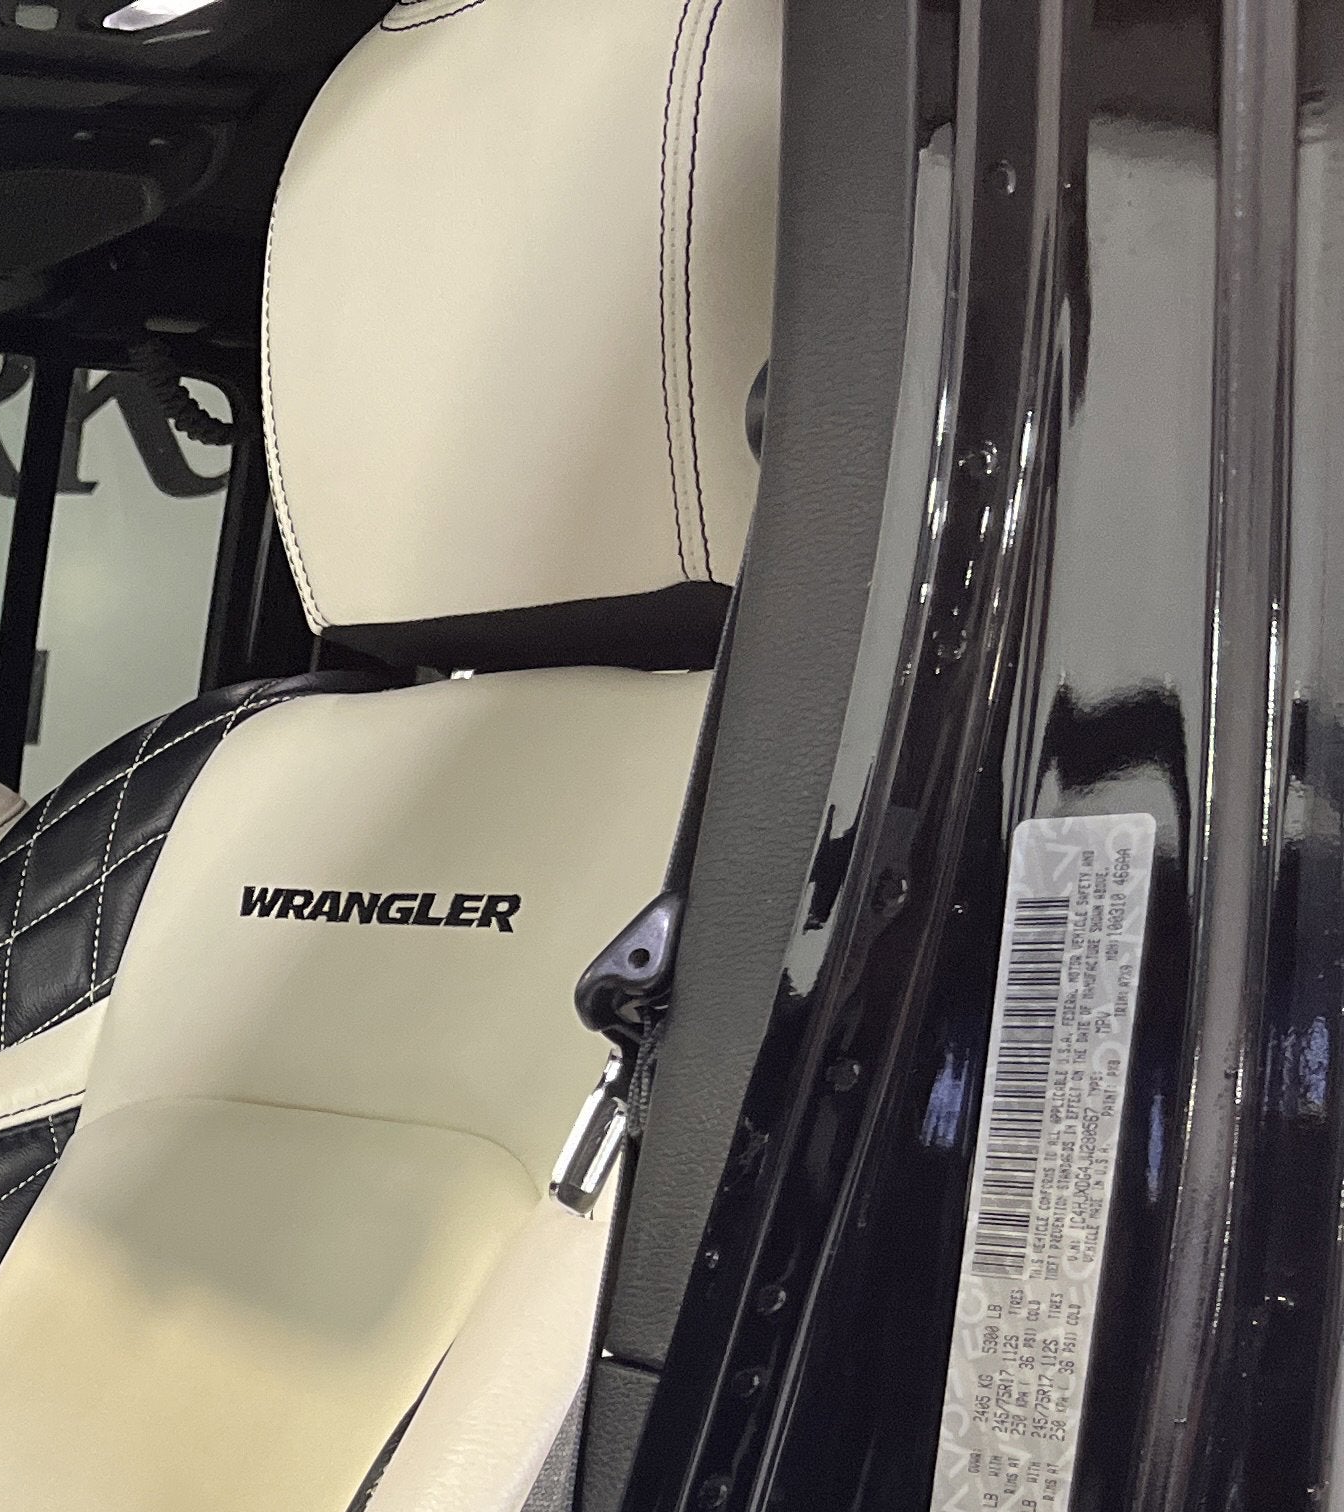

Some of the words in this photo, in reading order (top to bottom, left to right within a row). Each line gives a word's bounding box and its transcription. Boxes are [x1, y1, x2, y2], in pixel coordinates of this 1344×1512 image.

[1081, 850, 1094, 866] AND
[1076, 872, 1092, 905] SAFETY
[240, 886, 522, 933] WRANGLER
[1090, 904, 1105, 932] SHOWN
[1071, 911, 1088, 949] VEHICLE
[1067, 954, 1082, 982] MOTOR
[1081, 939, 1101, 998] MANUFACTURE
[1062, 988, 1078, 1026] FEDERAL
[1079, 1005, 1092, 1015] OF
[1076, 1021, 1090, 1042] DATE
[1094, 1010, 1112, 1033] MPV
[1073, 1048, 1087, 1063] THE
[1071, 1070, 1084, 1080] ON
[1049, 1070, 1068, 1123] APPLICABLE
[1066, 1086, 1082, 1119] EFFECT
[1047, 1129, 1060, 1145] ALL
[1064, 1124, 1076, 1134] IN
[1044, 1151, 1057, 1161] TO
[1057, 1140, 1075, 1189] STANDARDS
[1038, 1167, 1055, 1210] CONFORMS
[1092, 1179, 1105, 1190] IN
[1088, 1197, 1103, 1218] MADE
[1049, 1195, 1068, 1249] PREVENTION
[1033, 1215, 1049, 1253] VEHICLE
[1082, 1224, 1099, 1263] VEHICLE
[1029, 1258, 1043, 1279] THIS
[1045, 1254, 1060, 1281] THEFT
[986, 1302, 1002, 1319] LB
[1008, 1288, 1024, 1316] TIRES
[1026, 1299, 1041, 1322] COLD
[1048, 1292, 1063, 1320] TIRES
[1066, 1303, 1081, 1326] COLD
[982, 1324, 999, 1354] 5300
[1001, 1333, 1019, 1363] 112S
[1019, 1354, 1035, 1370] 36
[1040, 1337, 1058, 1367] 112S
[1059, 1359, 1074, 1375] 36
[977, 1373, 993, 1389] KG
[973, 1394, 990, 1423] 2405
[992, 1368, 1015, 1433] 245/75R17
[1031, 1373, 1053, 1439] 245/75R17
[1055, 1395, 1069, 1413] KPA
[1010, 1413, 1027, 1436] 250
[1050, 1419, 1067, 1442] 250
[988, 1454, 1002, 1477] WITH
[1007, 1456, 1020, 1468] AT
[1026, 1460, 1041, 1483] WITH
[1046, 1462, 1059, 1474] AT
[1004, 1472, 1018, 1495] RIMS
[1043, 1478, 1057, 1501] RIMS
[983, 1491, 998, 1508] LB
